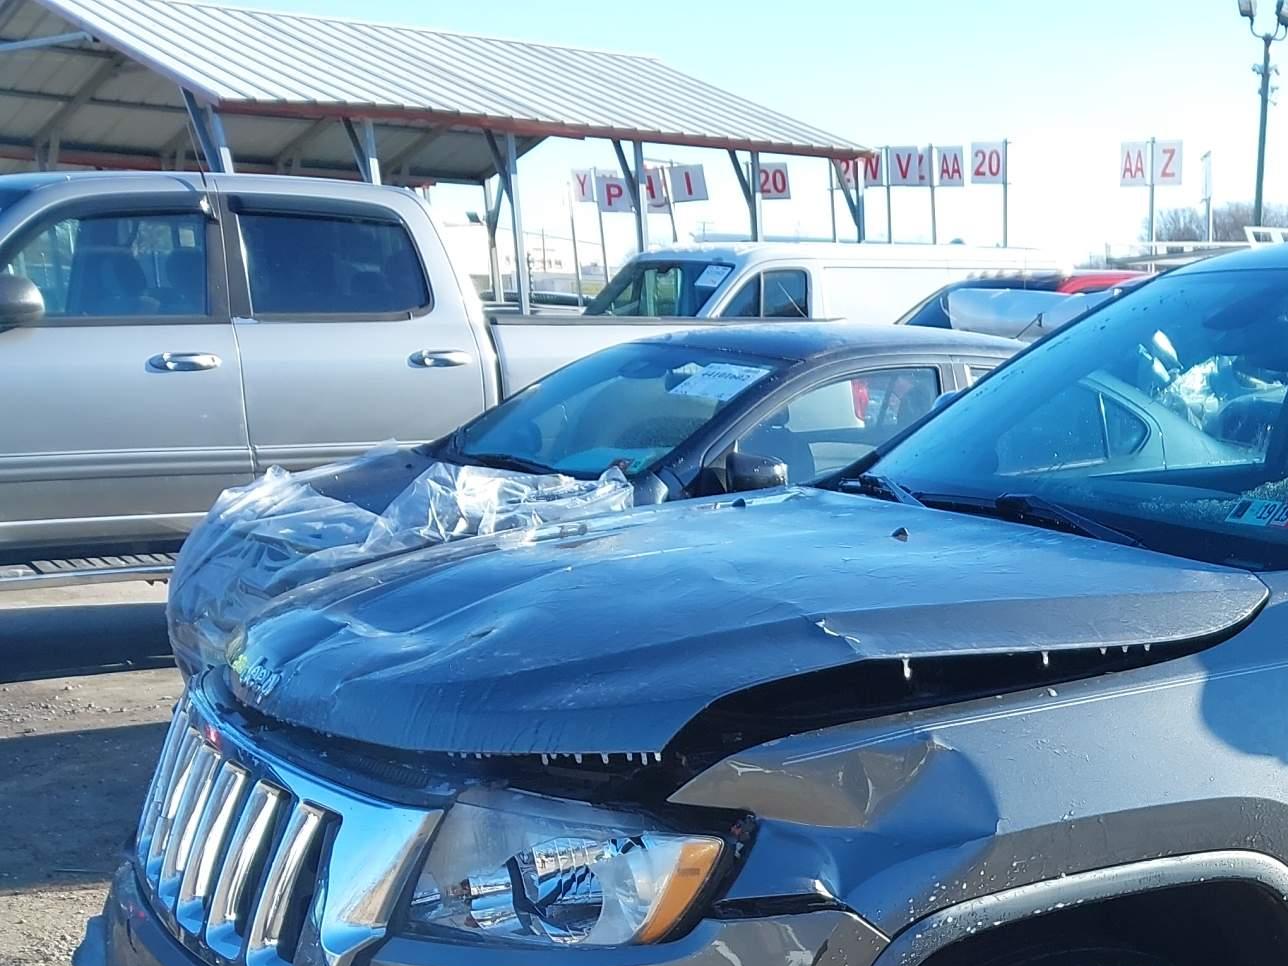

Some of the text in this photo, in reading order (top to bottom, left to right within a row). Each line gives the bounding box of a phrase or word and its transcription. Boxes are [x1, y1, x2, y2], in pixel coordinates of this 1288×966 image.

[896, 153, 912, 180] V
[941, 153, 962, 179] AA
[974, 150, 1000, 176] 20
[1122, 149, 1176, 179] AA Z
[576, 173, 587, 197] Y
[684, 171, 693, 196] I
[759, 168, 787, 194] 20
[605, 183, 623, 206] P
